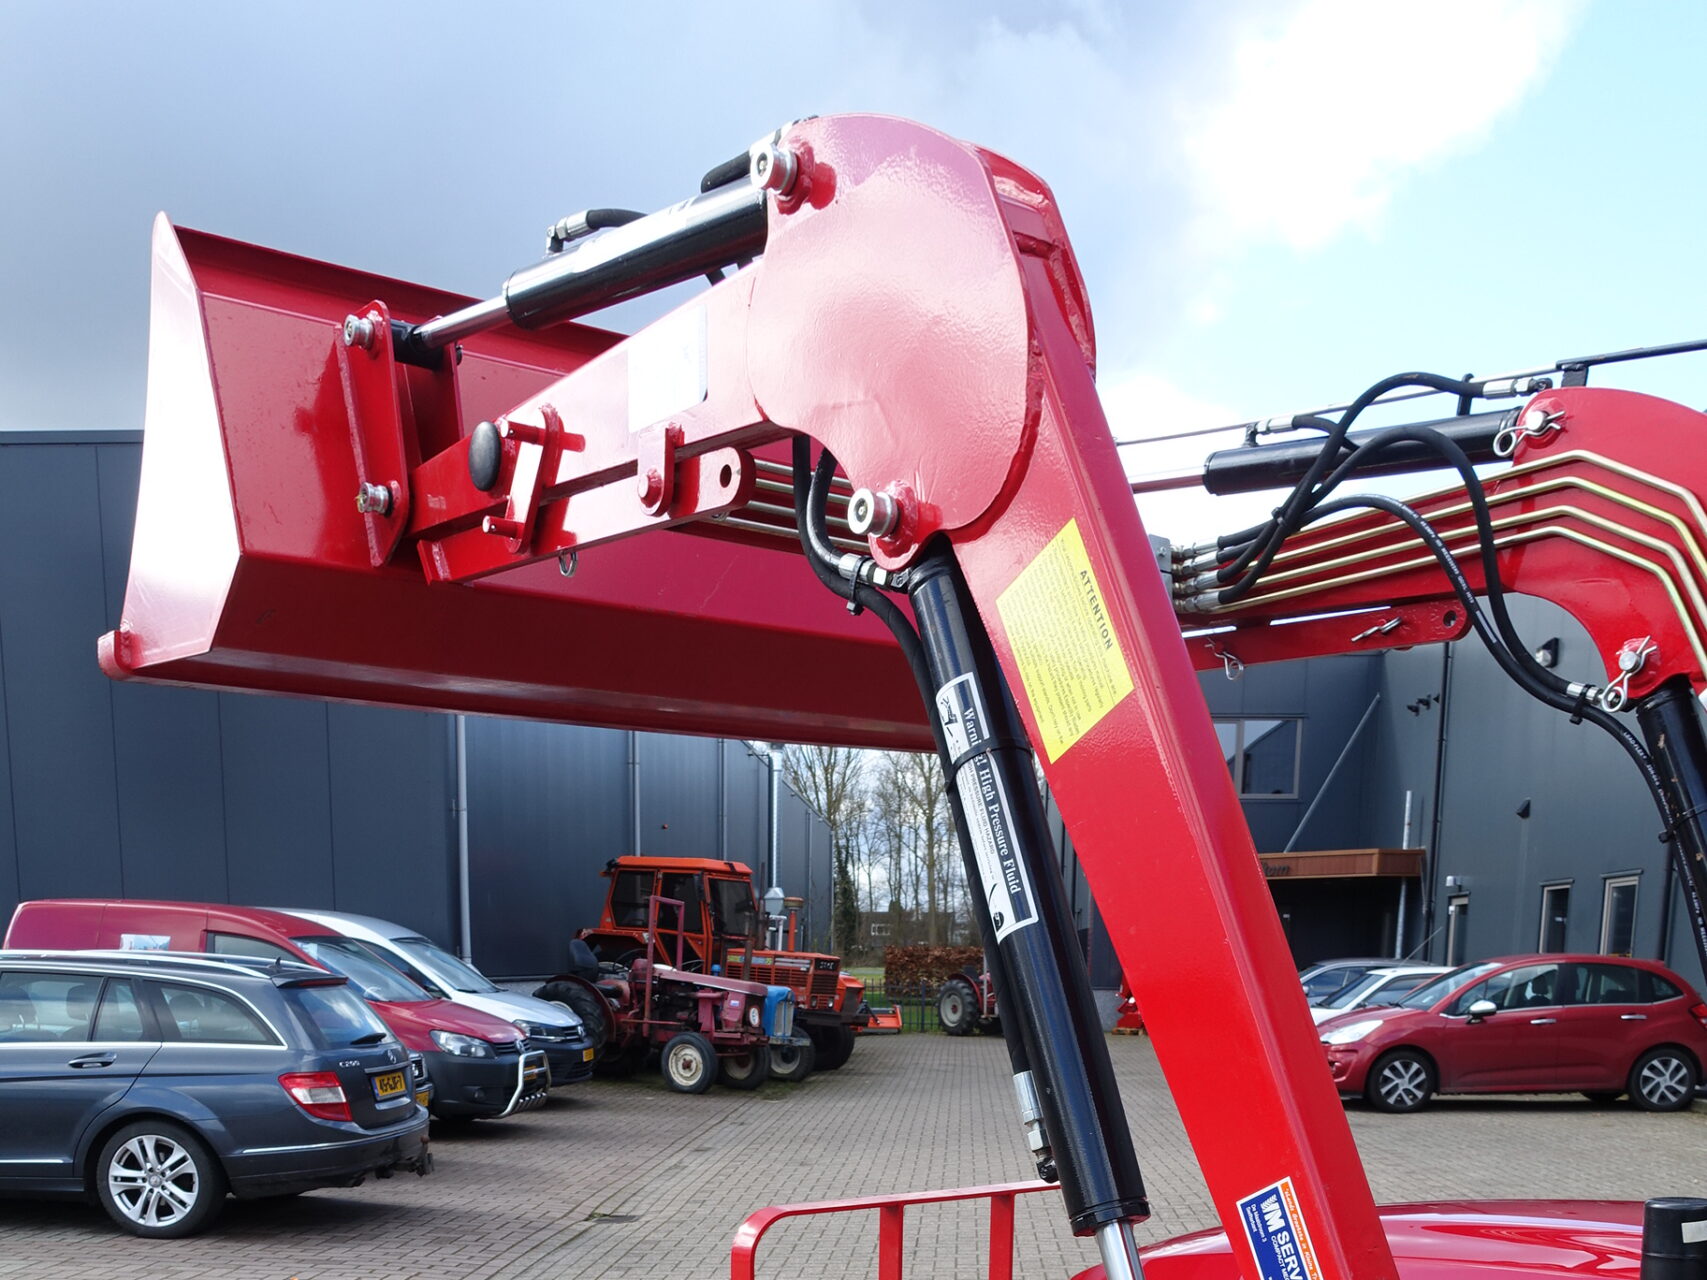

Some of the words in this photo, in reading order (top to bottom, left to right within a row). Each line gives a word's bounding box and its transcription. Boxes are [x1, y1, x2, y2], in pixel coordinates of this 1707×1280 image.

[1079, 566, 1113, 651] ATTENTION
[961, 705, 987, 768] Warnig!
[977, 766, 996, 803] High
[987, 800, 1011, 858] Pressure
[1001, 856, 1022, 896] Fluid
[1269, 1234, 1285, 1268] COMPACT
